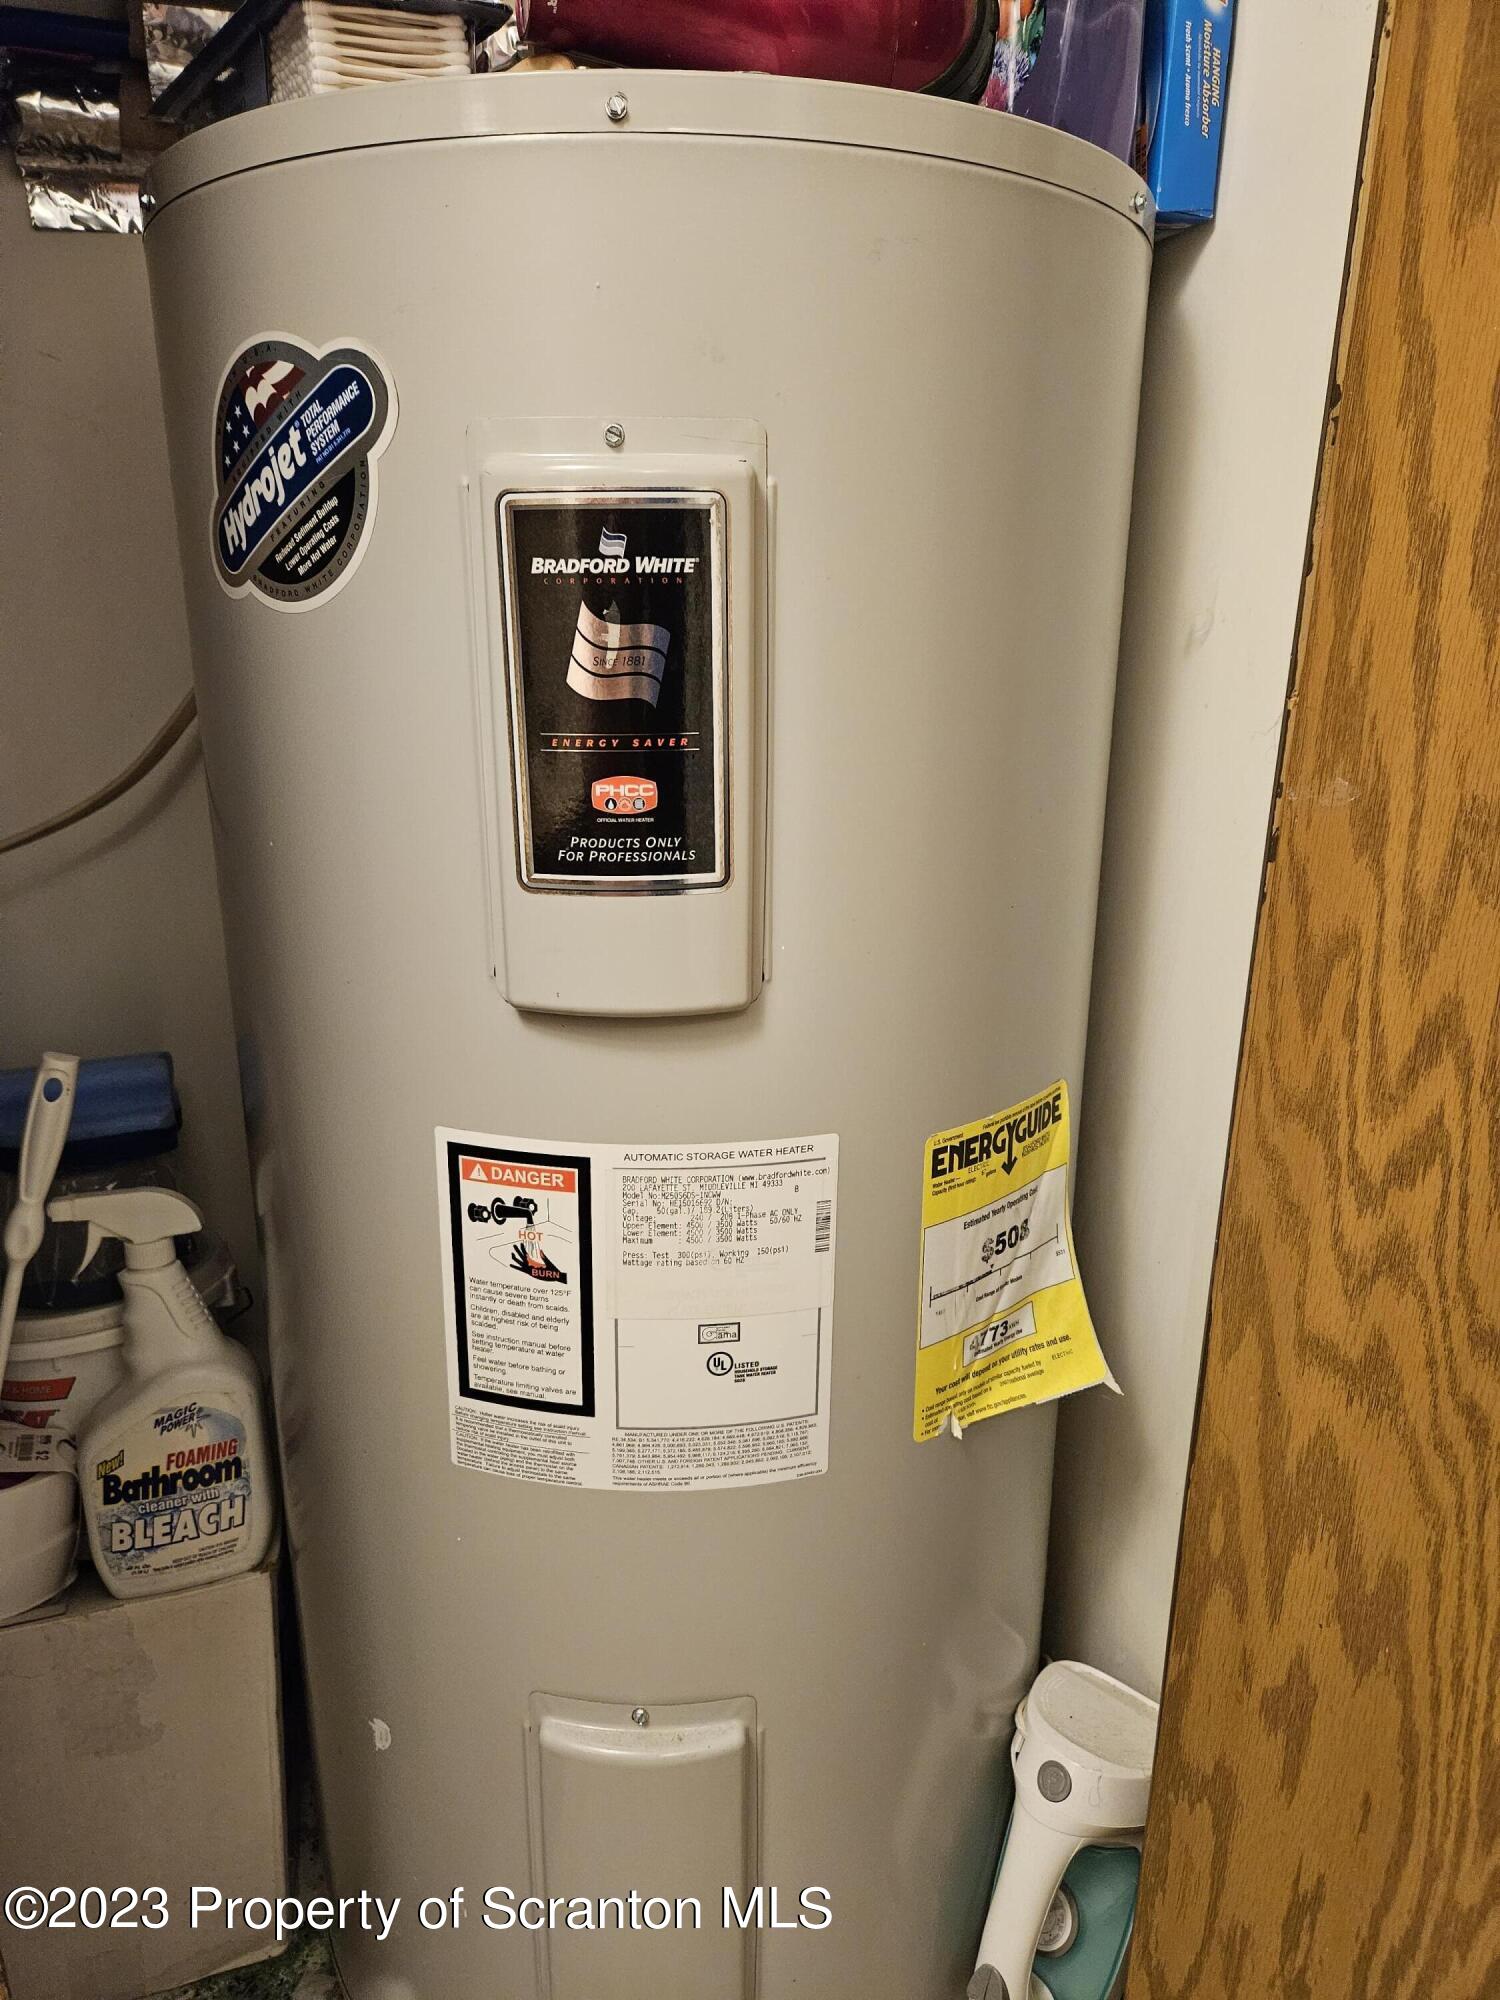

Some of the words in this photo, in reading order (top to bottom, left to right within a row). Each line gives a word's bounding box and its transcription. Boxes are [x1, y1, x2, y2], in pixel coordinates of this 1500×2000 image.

[1184, 21, 1192, 42] Fresh
[1203, 19, 1212, 78] Moisture
[1211, 47, 1221, 107] HANGING
[1201, 79, 1211, 139] Absorber
[300, 399, 324, 428] TOTAL
[305, 380, 360, 442] PERFORMANCE
[310, 419, 340, 457] SYSTEM
[223, 424, 307, 556] Hydrojet
[270, 481, 325, 542] FEATURING
[275, 538, 296, 563] Reduced
[294, 516, 319, 542] Sediment
[316, 496, 339, 518] Buildup
[304, 568, 334, 593] WHITE
[337, 460, 367, 566] CORPORATION
[285, 553, 300, 572] Lower
[299, 529, 325, 556] Operating
[323, 513, 340, 533] Costs
[297, 558, 313, 576] More
[310, 548, 321, 561] Hot
[319, 535, 337, 554] Water
[531, 557, 630, 574] BRADFORD
[635, 556, 695, 574] WHITE
[544, 576, 684, 585] CORPORATION
[622, 656, 646, 667] 1881
[552, 738, 620, 747] ENERGY
[632, 737, 689, 747] SAVER
[595, 783, 655, 797] PHCC
[570, 836, 640, 849] PRODUCTS
[645, 836, 682, 848] ONLY
[557, 850, 584, 862] FOR
[589, 850, 696, 862] PROFESSIONALS
[931, 1093, 1062, 1179] ENERGYGUIDE
[942, 1132, 963, 1145] Government
[623, 1153, 684, 1162] AUTOMATIC
[686, 1151, 735, 1161] STORAGE
[738, 1149, 774, 1159] WATER
[775, 1144, 814, 1156] HEATER
[491, 1166, 564, 1188] DANGER
[622, 1176, 657, 1184] BRADFORD
[661, 1176, 682, 1184] WHITE
[686, 1174, 734, 1183] CORPORATION
[738, 1167, 830, 1181] (www.bradfordwhite.com)
[622, 1184, 635, 1192] 200
[639, 1183, 678, 1192] LAFAYETTE
[700, 1181, 746, 1191] MIDDLEVILLE
[750, 1181, 758, 1189] MI
[762, 1179, 783, 1188] 49333
[622, 1199, 648, 1207] Serial
[737, 1211, 766, 1219] 1-Phase
[782, 1207, 798, 1215] ONLY
[963, 1211, 990, 1230] Estimated
[991, 1204, 1006, 1217] Yearly
[1006, 1192, 1028, 1209] Operating
[622, 1221, 644, 1230] Upper
[686, 1221, 703, 1229] 4500
[716, 1220, 733, 1228] 3500
[737, 1219, 758, 1227] Watts
[622, 1229, 644, 1237] Lower
[518, 1230, 543, 1241] HOT
[716, 1235, 733, 1243] 3500
[737, 1234, 758, 1242] Watts
[981, 1218, 1030, 1264] $508
[622, 1259, 652, 1268] Wattage
[657, 1259, 682, 1267] rating
[719, 1249, 749, 1258] Working
[531, 1268, 560, 1279] BURN
[469, 1276, 488, 1286] Water
[490, 1280, 530, 1293] temperature
[532, 1287, 548, 1295] over
[483, 1288, 503, 1297] cause
[505, 1291, 527, 1300] severe
[530, 1294, 549, 1303] burns
[507, 1298, 526, 1307] death
[470, 1303, 499, 1316] Children,
[502, 1309, 529, 1319] disabled
[546, 1316, 569, 1326] elderly
[491, 1315, 515, 1325] highest
[517, 1319, 529, 1327] risk
[539, 1323, 558, 1332] being
[471, 1330, 484, 1339] See
[486, 1334, 520, 1345] instruction
[522, 1340, 546, 1349] manual
[548, 1343, 571, 1352] before
[471, 1338, 493, 1348] setting
[495, 1342, 535, 1354] temperature
[545, 1350, 565, 1358] water
[472, 1354, 486, 1362] Feel
[488, 1359, 506, 1367] water
[508, 1362, 530, 1371] before
[531, 1365, 557, 1375] bathing
[713, 1357, 727, 1371] UL
[734, 1361, 759, 1370] LISTED
[935, 1383, 948, 1395] Your
[948, 1378, 961, 1390] cost
[961, 1372, 971, 1384] will
[972, 1365, 991, 1379] depend
[999, 1352, 1010, 1366] your
[1011, 1348, 1028, 1360] utility
[1028, 1342, 1045, 1353] rates
[1046, 1338, 1057, 1348] and
[1058, 1334, 1072, 1345] use.
[1003, 1367, 1021, 1379] capacity
[1021, 1362, 1035, 1372] fueled
[1035, 1360, 1042, 1368] by
[474, 1373, 514, 1387] Temperature
[516, 1381, 540, 1392] limiting
[541, 1386, 563, 1394] valves
[154, 1402, 198, 1429] MAGIC
[166, 1438, 239, 1471] FOAMING
[96, 1450, 125, 1480] New!
[103, 1456, 243, 1505] Bathroom
[138, 1495, 188, 1514] cleaner
[189, 1489, 219, 1505] with
[111, 1494, 246, 1553] BLEACH
